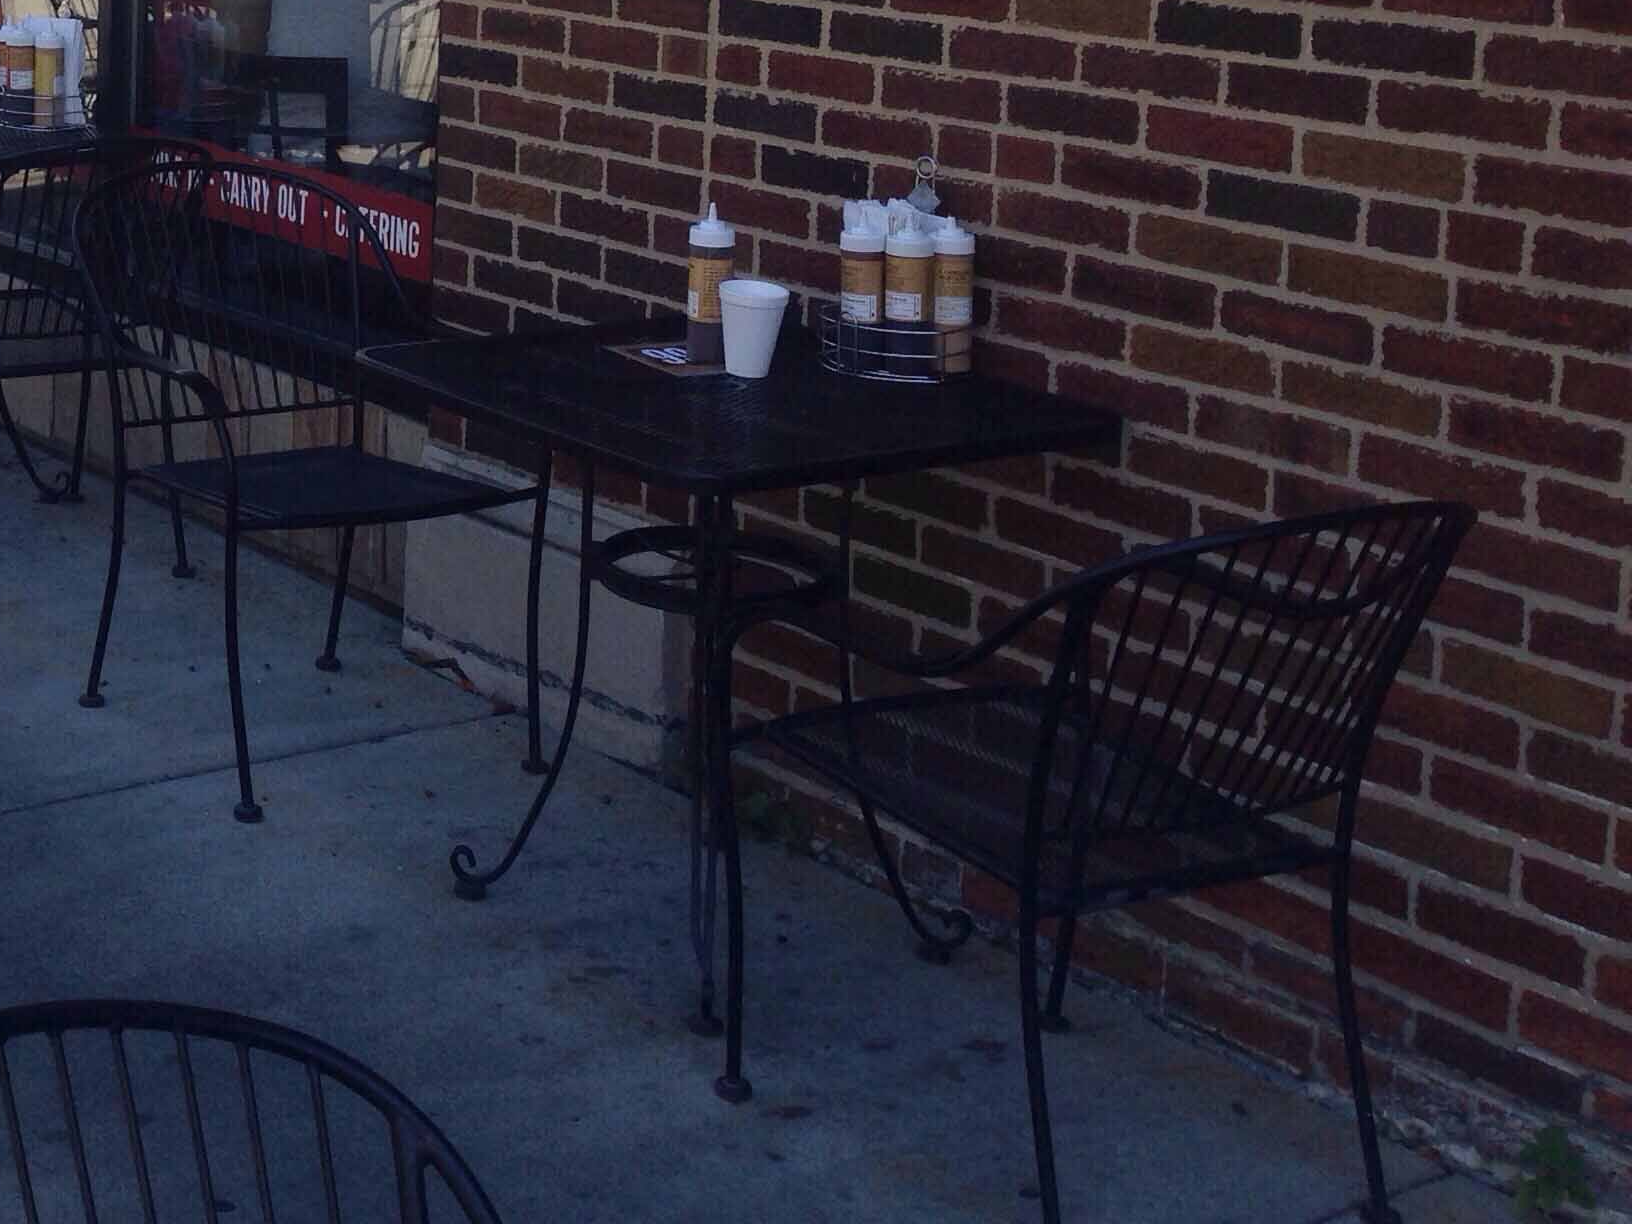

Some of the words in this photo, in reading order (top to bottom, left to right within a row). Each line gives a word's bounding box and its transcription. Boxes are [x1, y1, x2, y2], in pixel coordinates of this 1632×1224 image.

[220, 170, 269, 215] CARRY
[277, 183, 308, 225] OUT
[335, 204, 420, 258] CTERING
